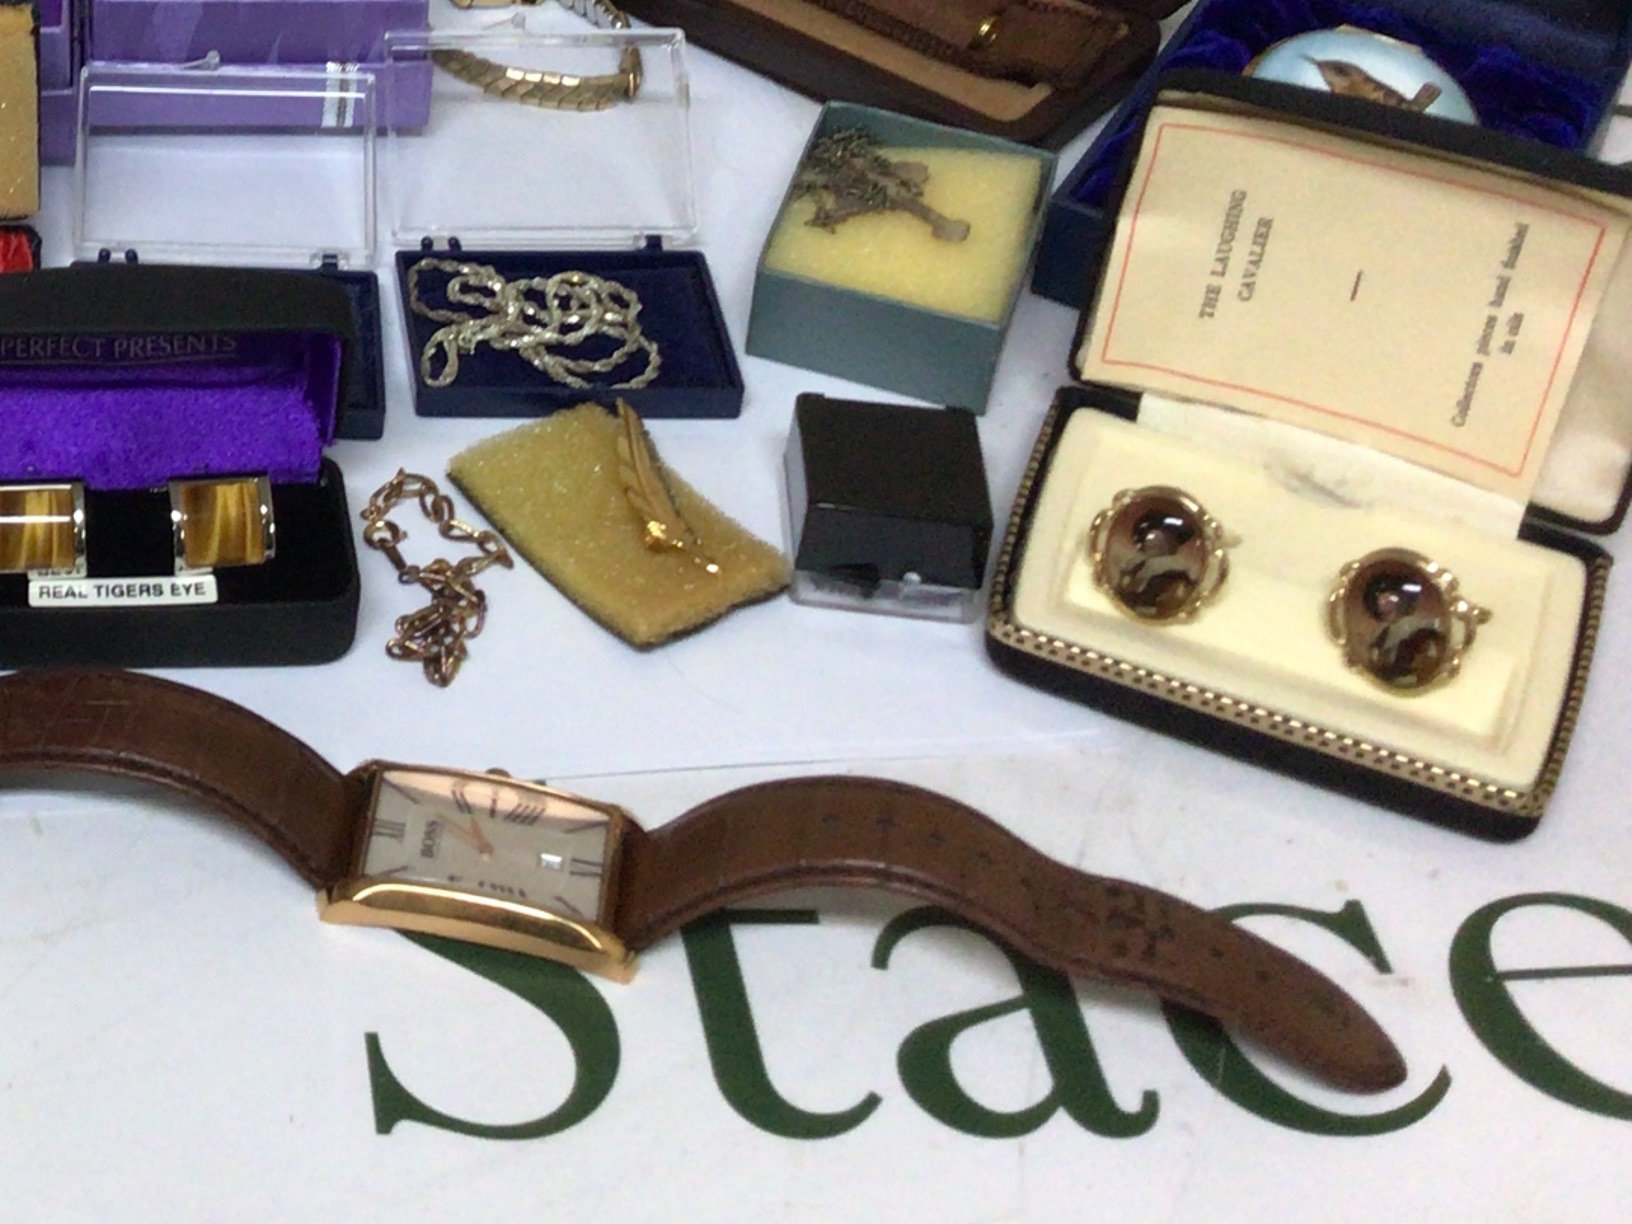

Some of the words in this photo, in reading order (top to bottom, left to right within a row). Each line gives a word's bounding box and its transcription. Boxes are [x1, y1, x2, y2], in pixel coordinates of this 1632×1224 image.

[1210, 188, 1248, 279] LAUGHING
[1237, 216, 1275, 303] CAVALIER
[1198, 283, 1223, 319] THE
[1487, 274, 1513, 309] hand
[0, 336, 106, 359] PERFECT
[113, 333, 237, 359] PRESENTS
[38, 584, 88, 601] REAL
[93, 582, 165, 600] TIGERS
[169, 581, 206, 597] EYE
